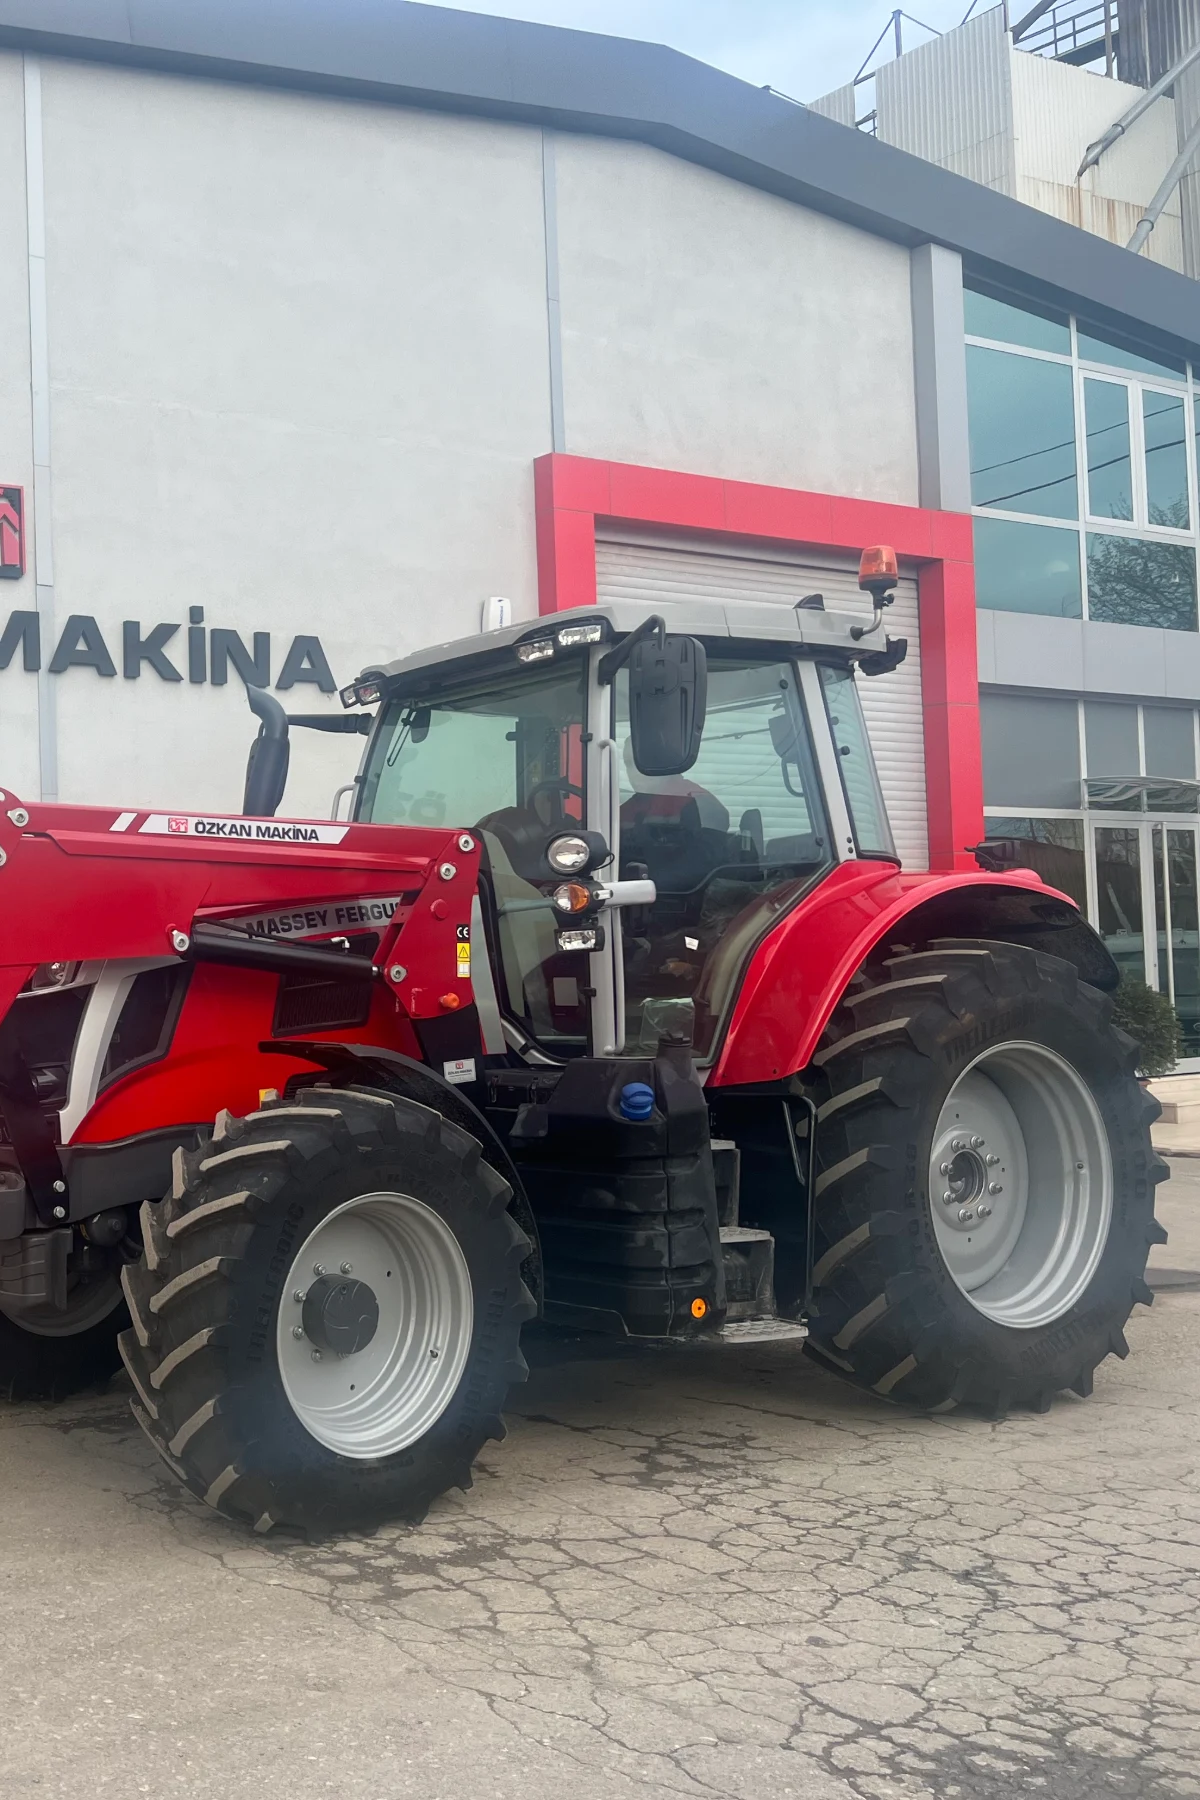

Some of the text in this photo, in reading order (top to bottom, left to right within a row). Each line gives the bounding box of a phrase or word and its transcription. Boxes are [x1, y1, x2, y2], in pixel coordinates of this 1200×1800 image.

[195, 819, 320, 842] ÖZKAN MAKİNA
[246, 901, 400, 935] MASSEY FERGU
